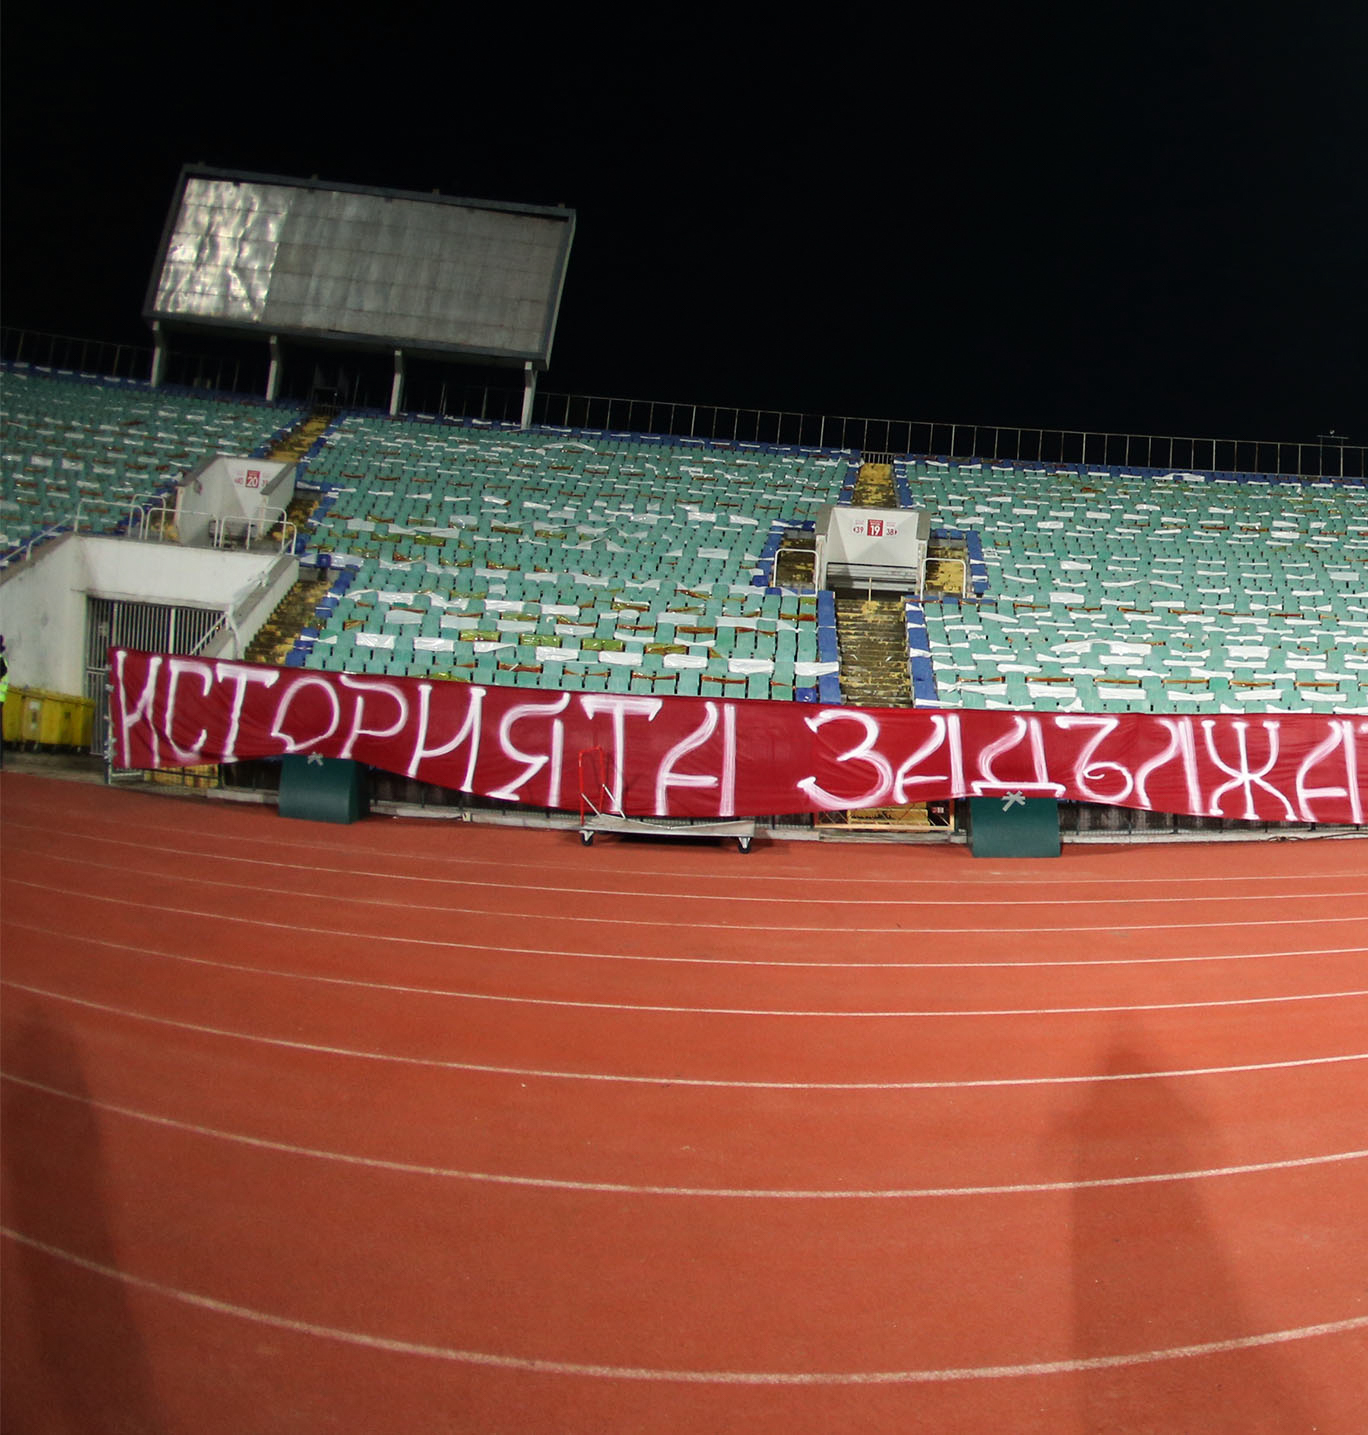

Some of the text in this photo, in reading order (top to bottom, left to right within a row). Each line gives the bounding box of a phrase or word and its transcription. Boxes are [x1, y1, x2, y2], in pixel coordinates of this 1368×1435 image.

[247, 477, 258, 487] 20
[870, 525, 880, 536] 19
[114, 649, 736, 816] ИСТОРИЯТА
